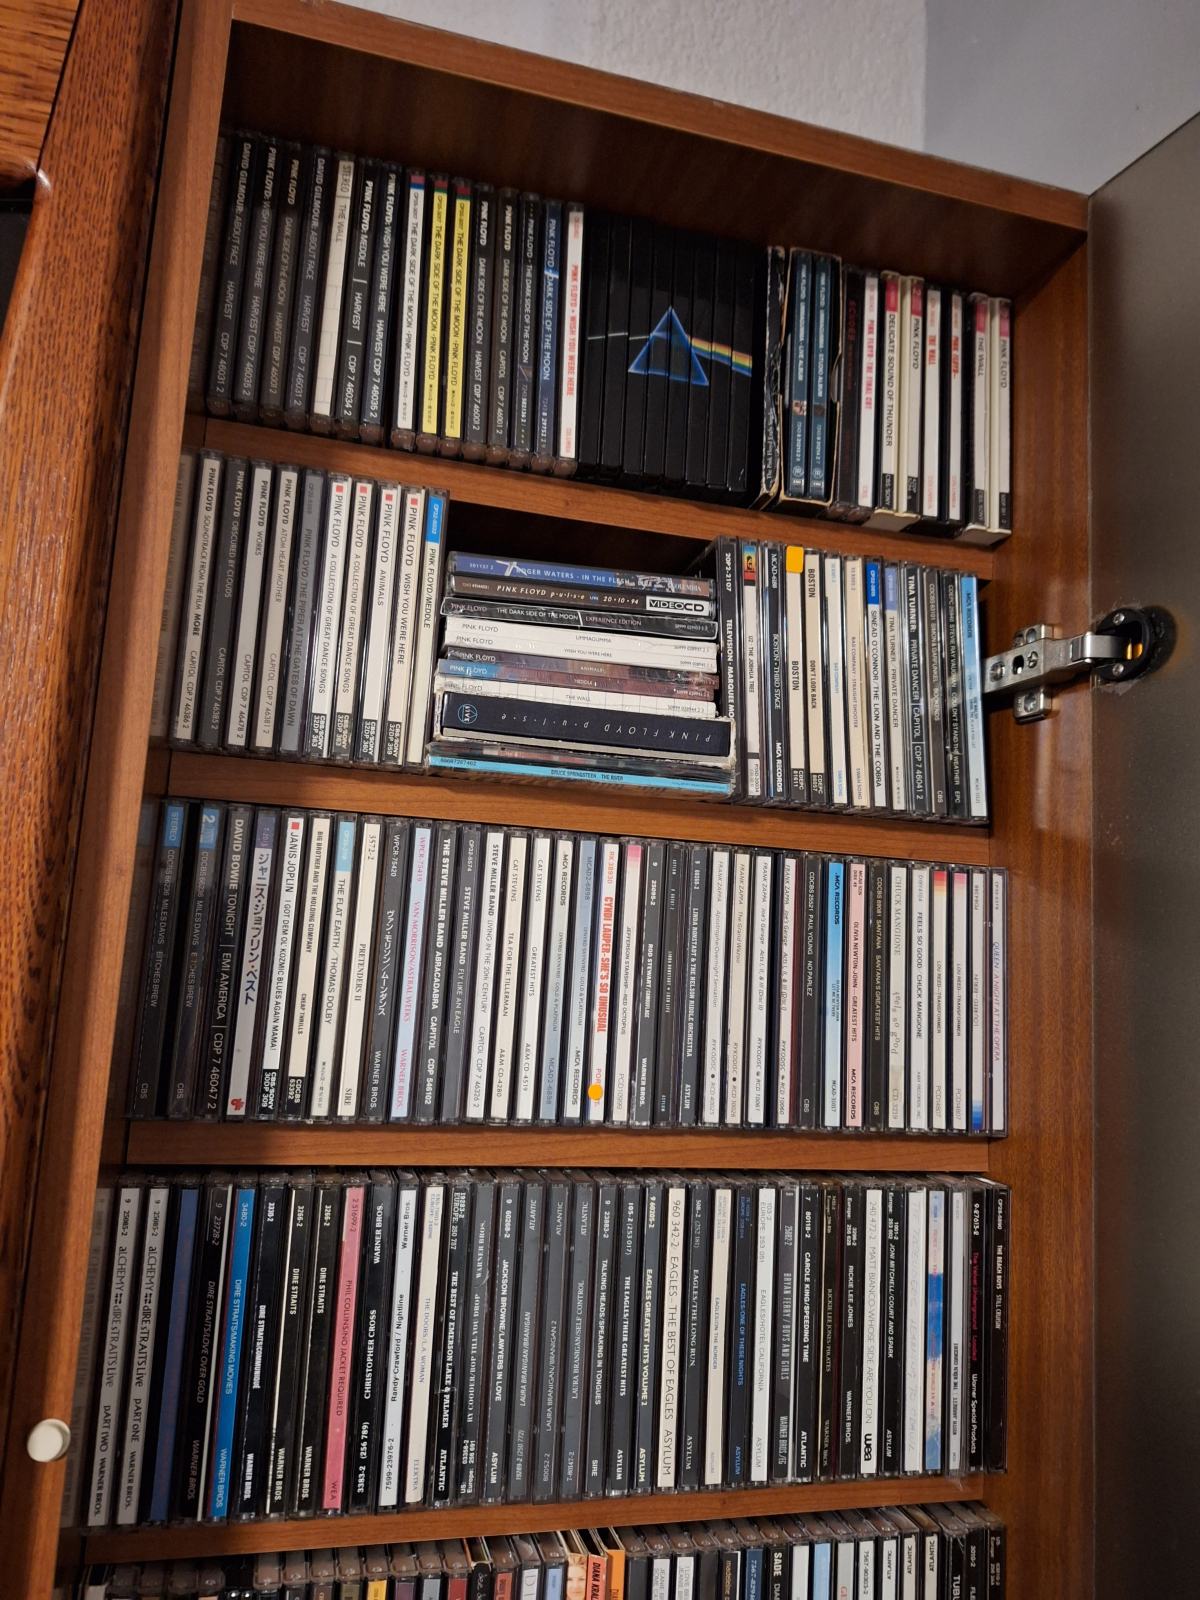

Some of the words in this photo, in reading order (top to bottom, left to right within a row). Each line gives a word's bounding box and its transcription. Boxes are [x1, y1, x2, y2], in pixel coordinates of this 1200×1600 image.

[231, 819, 245, 852] DAVID
[441, 838, 451, 855] THE
[227, 854, 241, 889] BOWIE
[439, 856, 449, 886] STEVE
[223, 893, 238, 936] TONIGHT
[437, 887, 447, 920] MILLER
[602, 896, 614, 921] CYNDI
[435, 922, 444, 947] BAND
[220, 952, 232, 970] EMI
[215, 972, 230, 1019] AMERICA
[430, 951, 442, 1009] ABRACADABRA
[596, 995, 608, 1032] UNUSUAL
[211, 1032, 224, 1054] CDP
[427, 1016, 437, 1050] CAPITOL
[207, 1066, 220, 1099] 46047
[668, 1256, 679, 1296] EAGLES
[666, 1306, 677, 1328] THE
[665, 1331, 676, 1356] BEST
[663, 1378, 674, 1419] EAGLES
[661, 1429, 673, 1474] ASYLUM
